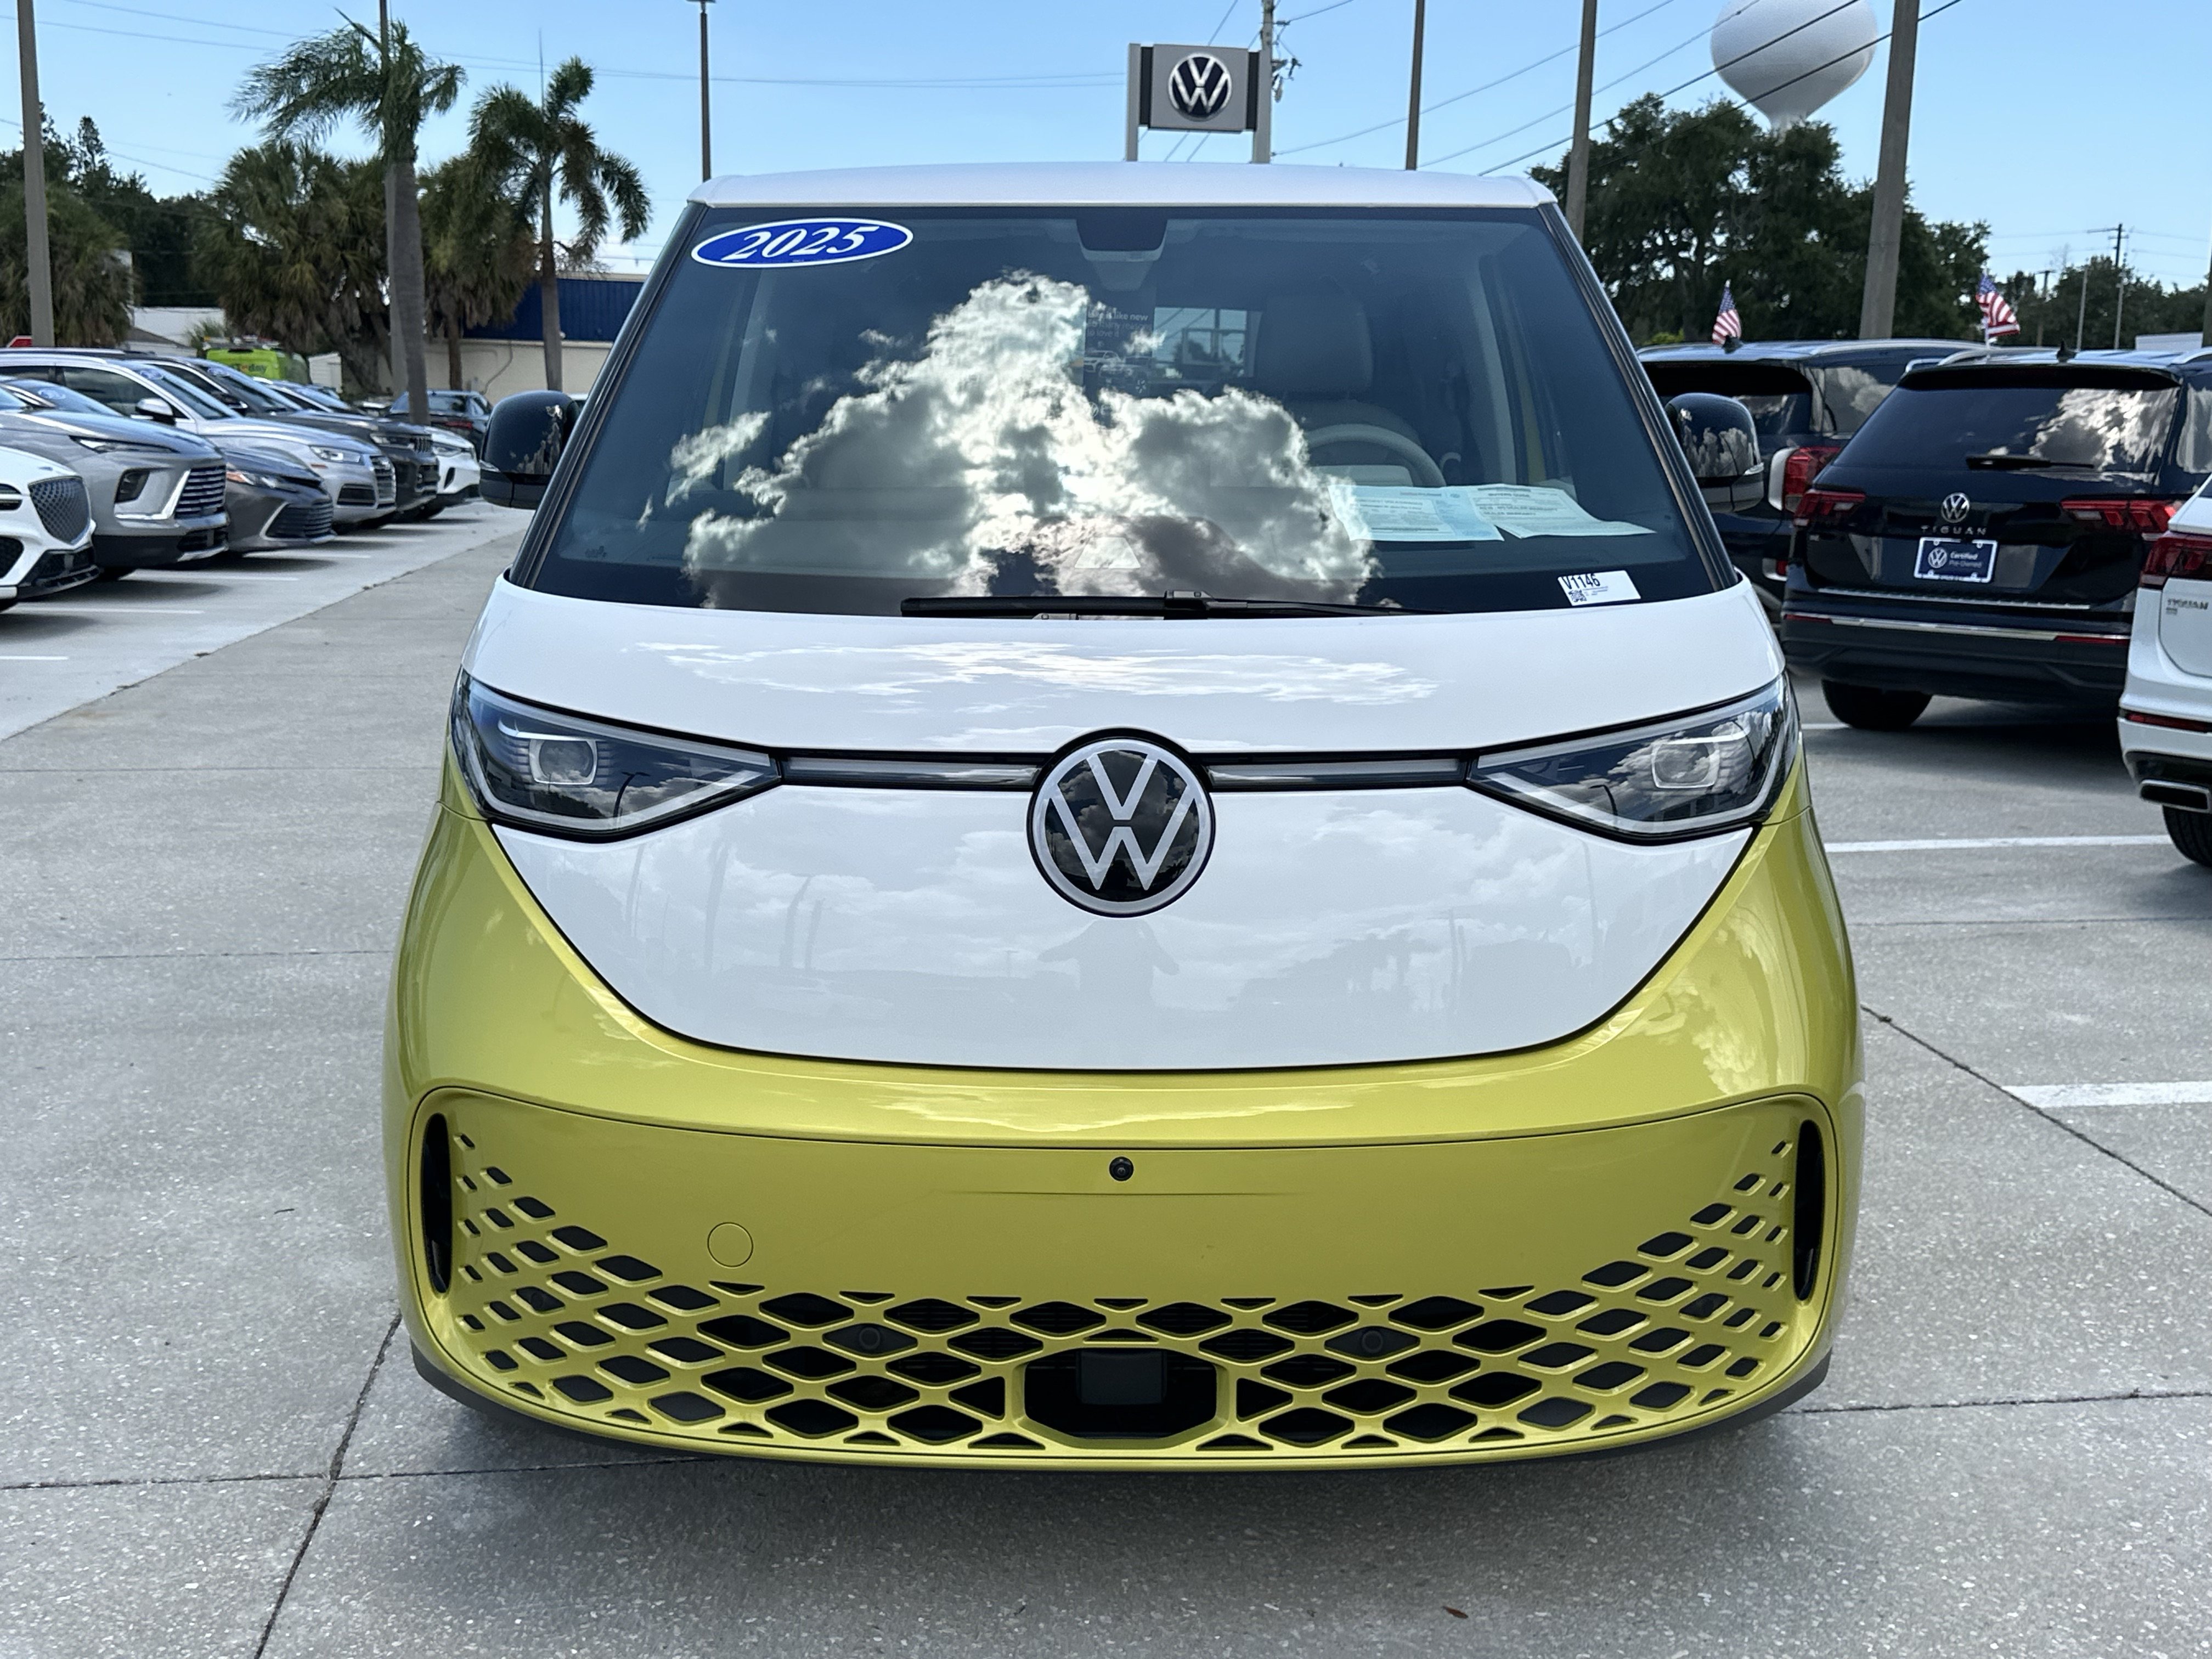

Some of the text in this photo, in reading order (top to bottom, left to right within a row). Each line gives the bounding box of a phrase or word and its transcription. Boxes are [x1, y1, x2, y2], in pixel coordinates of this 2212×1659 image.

[720, 225, 880, 261] 2025
[1920, 525, 1987, 535] TIGUAN
[1562, 573, 1601, 590] V1146
[1039, 744, 1205, 904] VW
